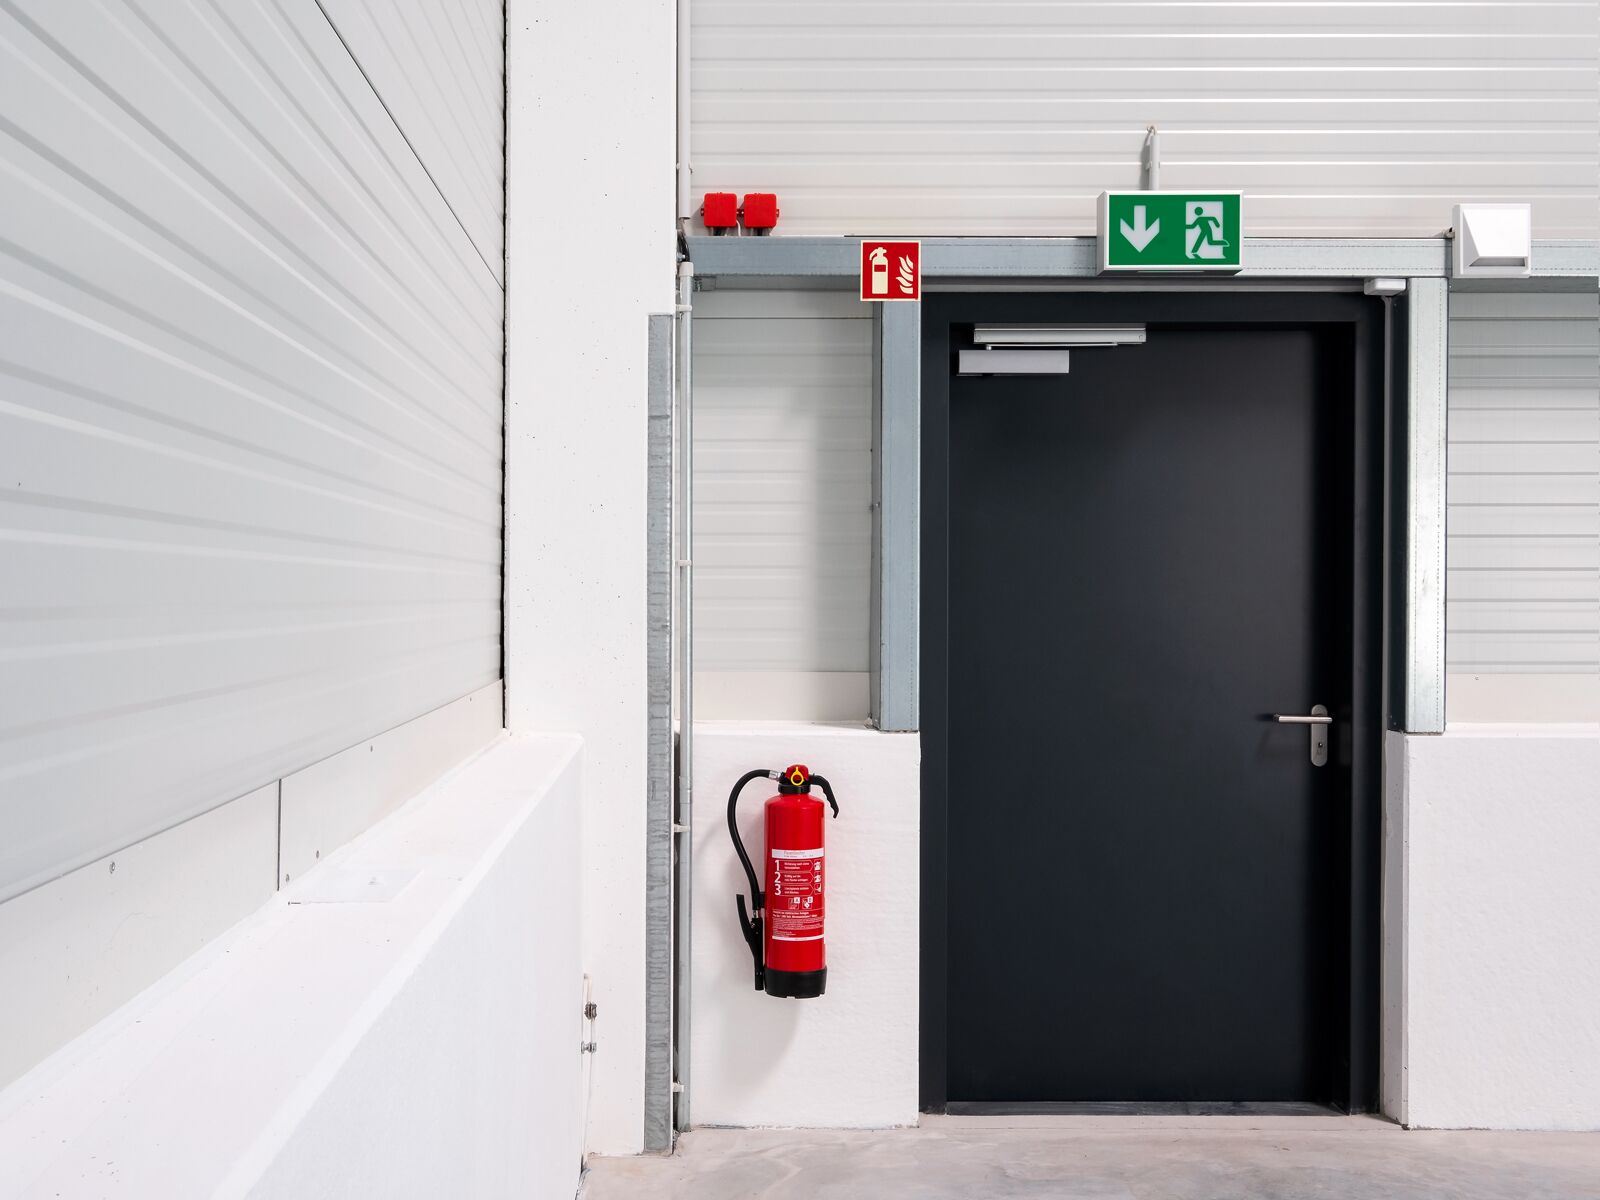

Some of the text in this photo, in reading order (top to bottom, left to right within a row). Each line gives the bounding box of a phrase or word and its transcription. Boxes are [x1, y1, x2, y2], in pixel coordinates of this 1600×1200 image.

[774, 860, 780, 872] 1
[774, 871, 781, 883] 2
[774, 883, 781, 896] 3
